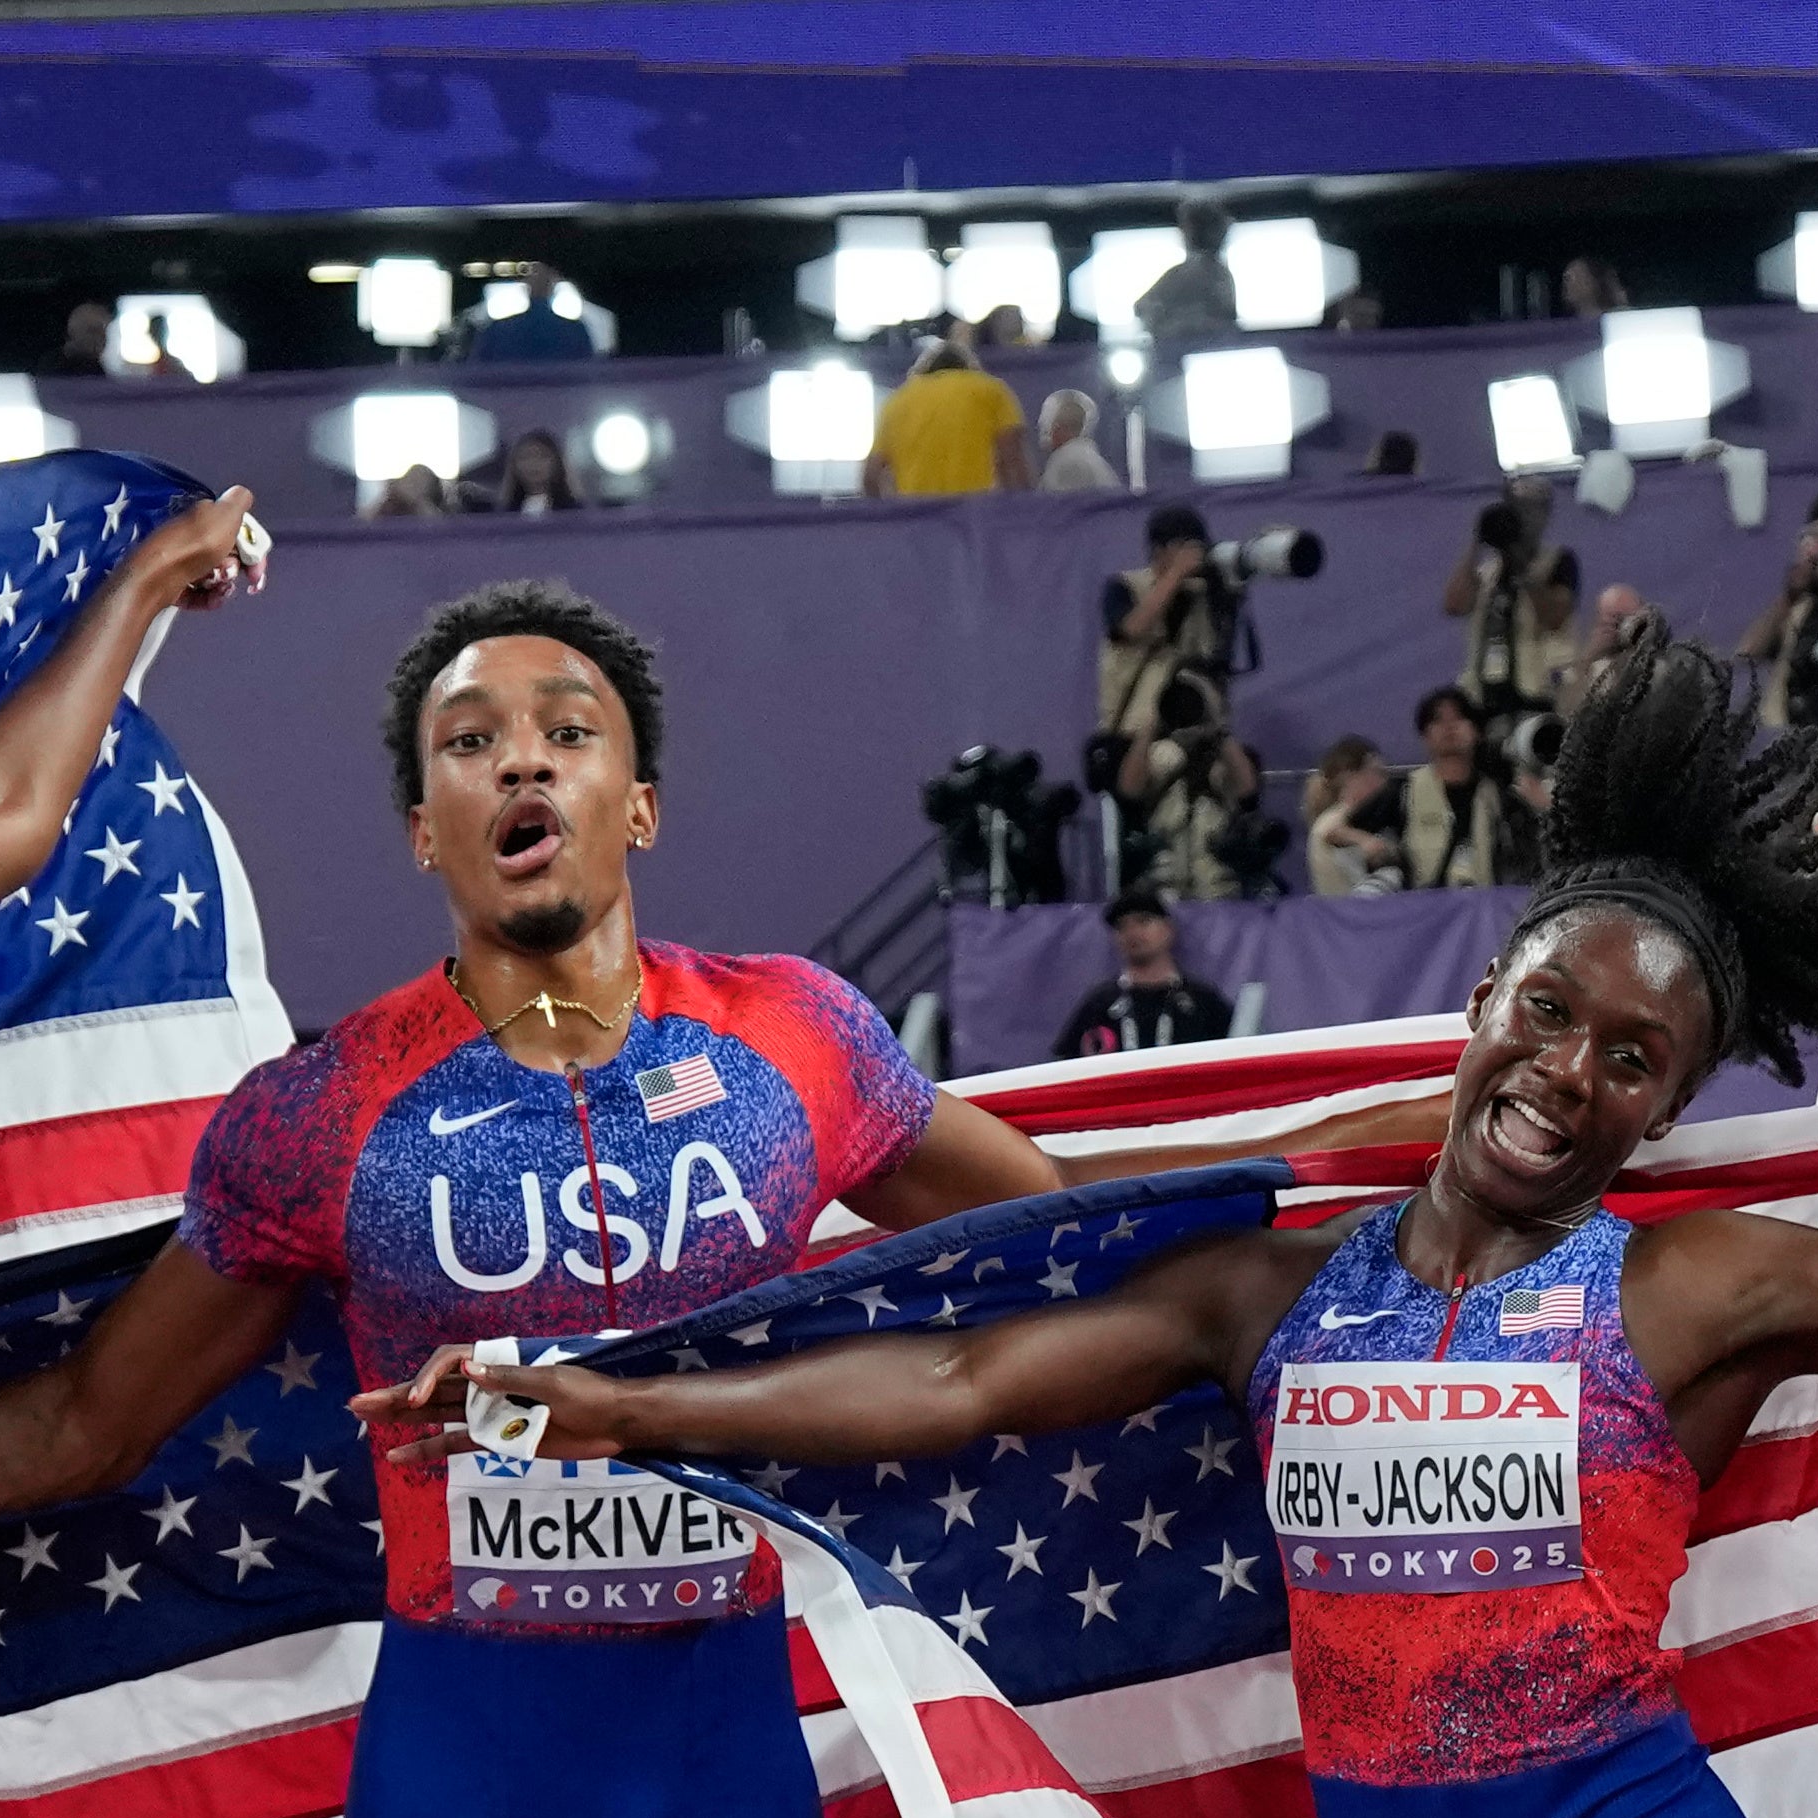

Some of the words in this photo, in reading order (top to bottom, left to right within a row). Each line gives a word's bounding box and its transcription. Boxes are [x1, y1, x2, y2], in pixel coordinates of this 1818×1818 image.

[431, 1141, 766, 1292] USA
[1280, 1383, 1569, 1426] HONDA
[1277, 1452, 1566, 1528] IRBY-JACKSON
[469, 1490, 745, 1559] McKIVER
[1337, 1546, 1500, 1577] TOKYO
[1512, 1542, 1567, 1572] 25
[531, 1578, 701, 1611] TOKYO
